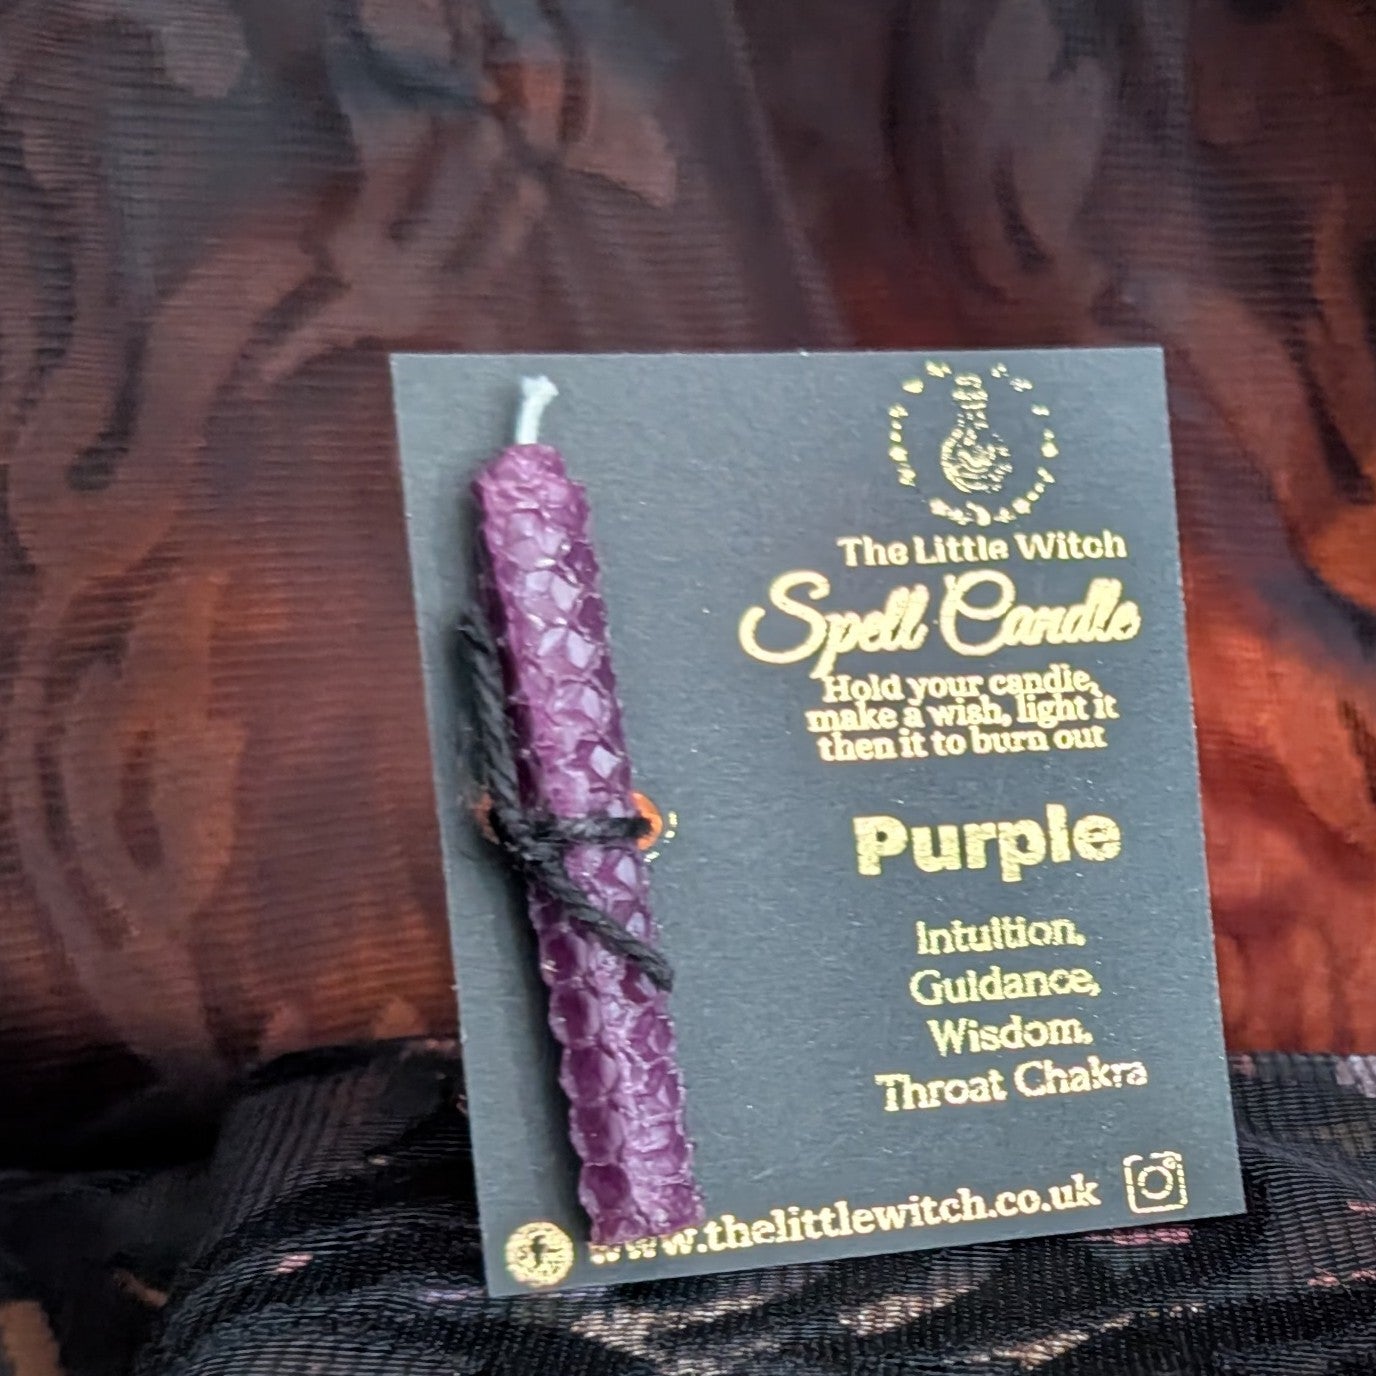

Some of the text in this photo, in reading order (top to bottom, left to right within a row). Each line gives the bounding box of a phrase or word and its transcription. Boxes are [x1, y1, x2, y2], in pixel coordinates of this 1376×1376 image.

[836, 530, 1127, 567] The Little Witch
[739, 569, 1142, 680] Spell Candle
[821, 673, 905, 704] Hold
[907, 674, 984, 707] your
[805, 700, 899, 733] make
[903, 706, 925, 729] a
[1014, 693, 1090, 729] light
[1093, 694, 1120, 721] it
[817, 725, 1108, 762] then it to burn out
[853, 804, 1122, 883] Purple
[874, 1055, 1148, 1112] Throat Chakra
